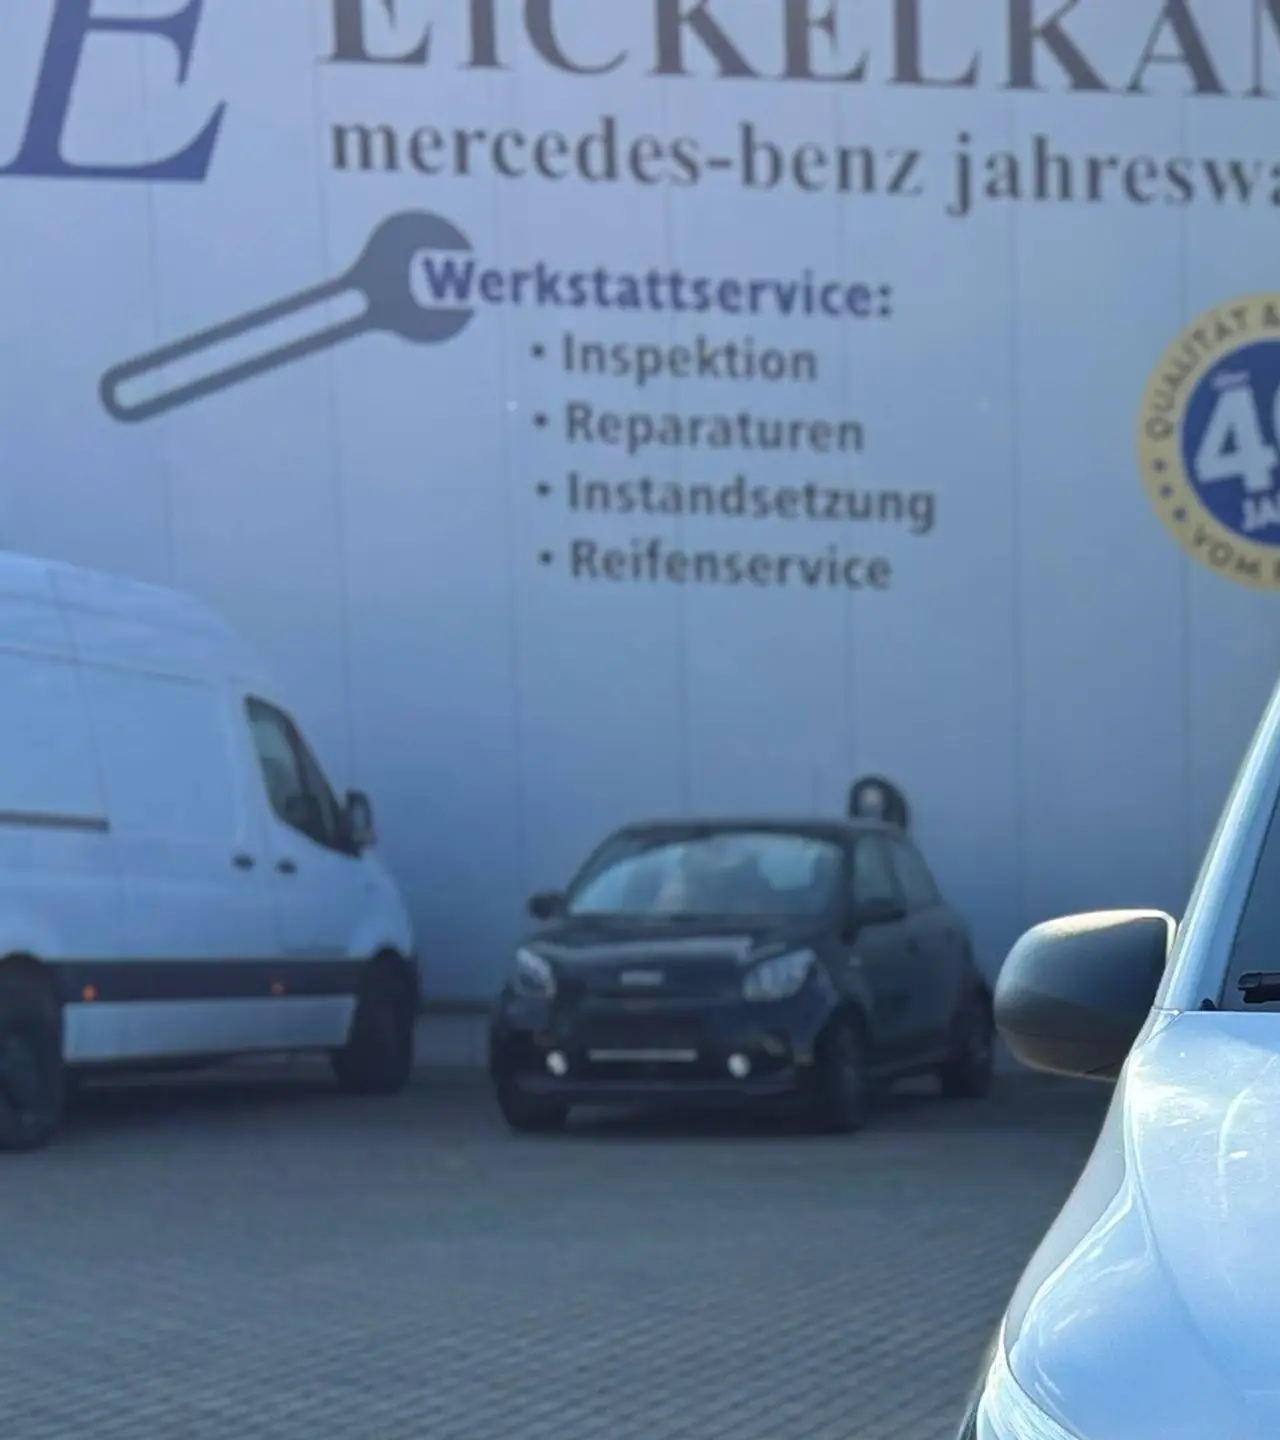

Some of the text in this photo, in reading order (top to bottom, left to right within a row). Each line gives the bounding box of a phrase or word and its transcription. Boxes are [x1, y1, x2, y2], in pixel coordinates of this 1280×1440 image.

[329, 116, 923, 196] mercedes-benz
[421, 256, 893, 318] Werkstattservice:
[563, 331, 818, 390] Inspektion
[565, 401, 865, 457] Reparaturen
[567, 471, 938, 535] Instandsetzung
[569, 537, 893, 591] Reifenservice
